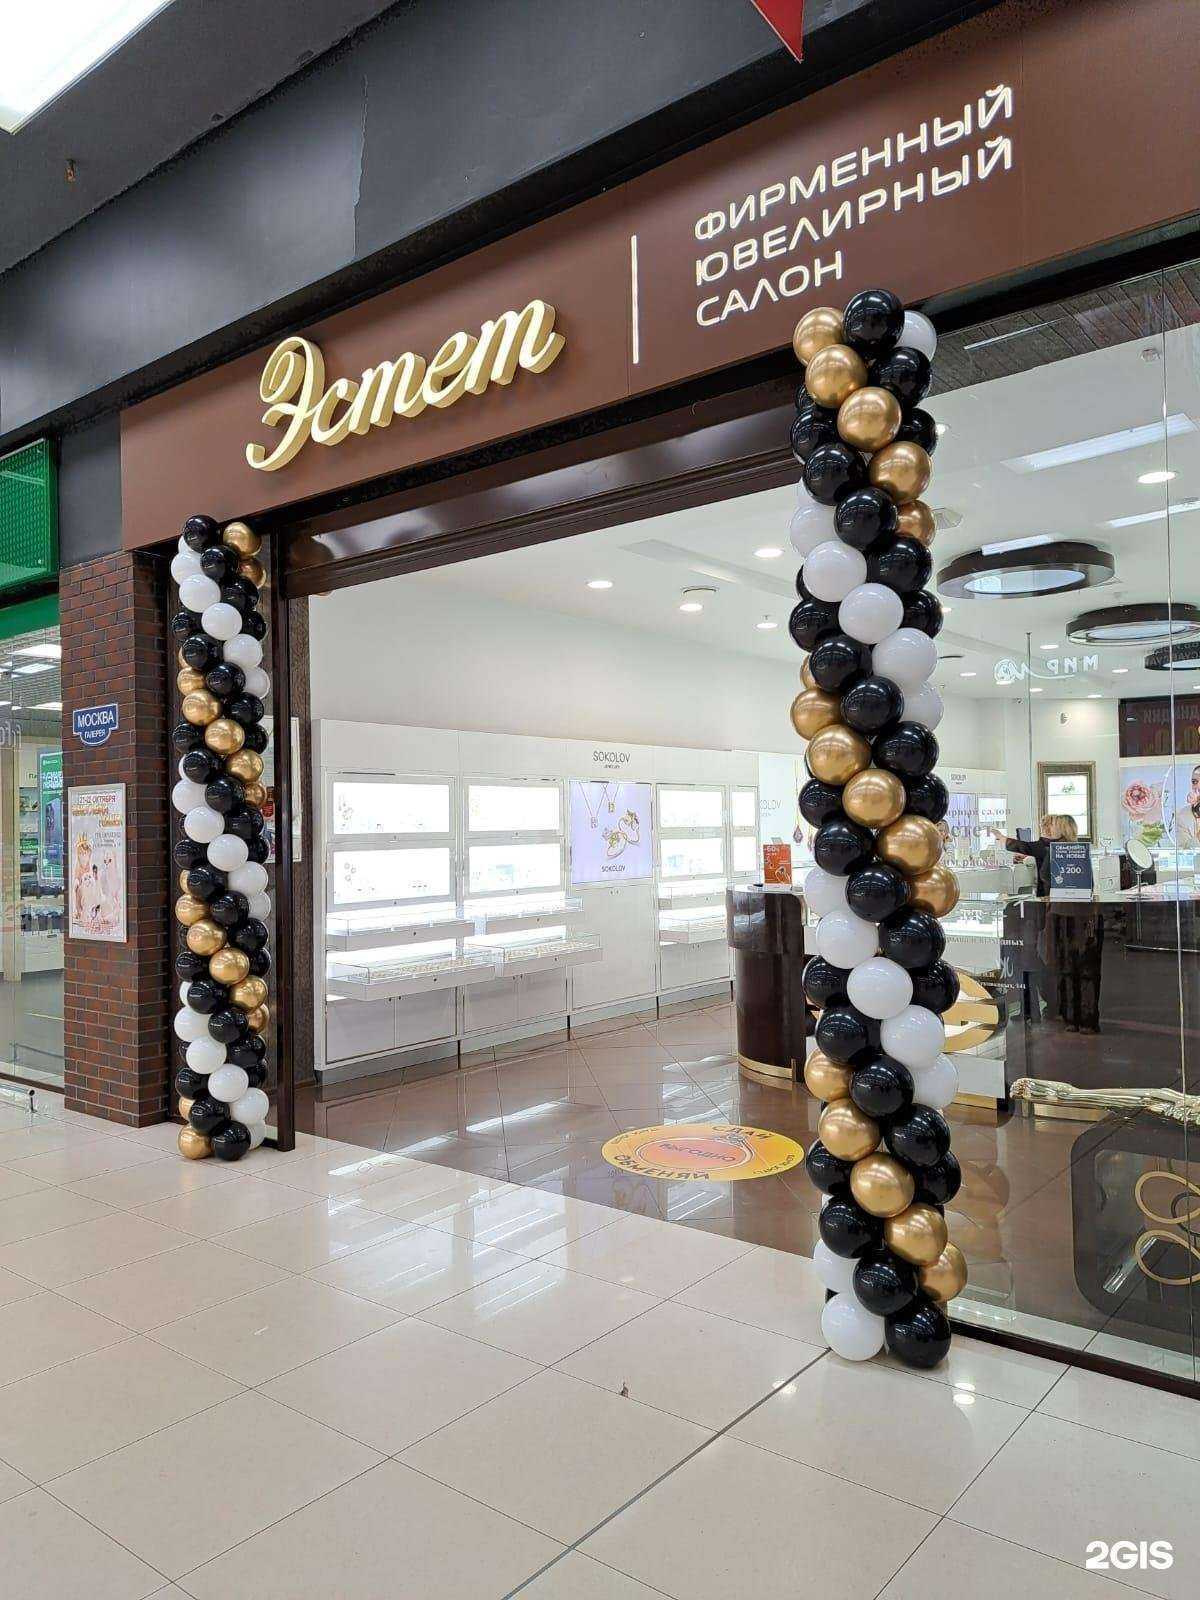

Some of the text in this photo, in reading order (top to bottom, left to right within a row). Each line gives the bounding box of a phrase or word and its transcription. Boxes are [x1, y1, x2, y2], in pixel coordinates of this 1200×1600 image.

[694, 84, 1013, 240] ФИРМЕННЫЙ
[695, 135, 1013, 286] ЮВЕЛИРНЫЙ
[696, 250, 843, 327] САЛОН
[245, 299, 566, 472] Эстет
[77, 710, 115, 728] МОСКВА
[592, 750, 631, 763] SOKOLOV
[601, 864, 626, 872] SOKOLOV
[613, 1153, 711, 1181] ОБМЕНЯЙ
